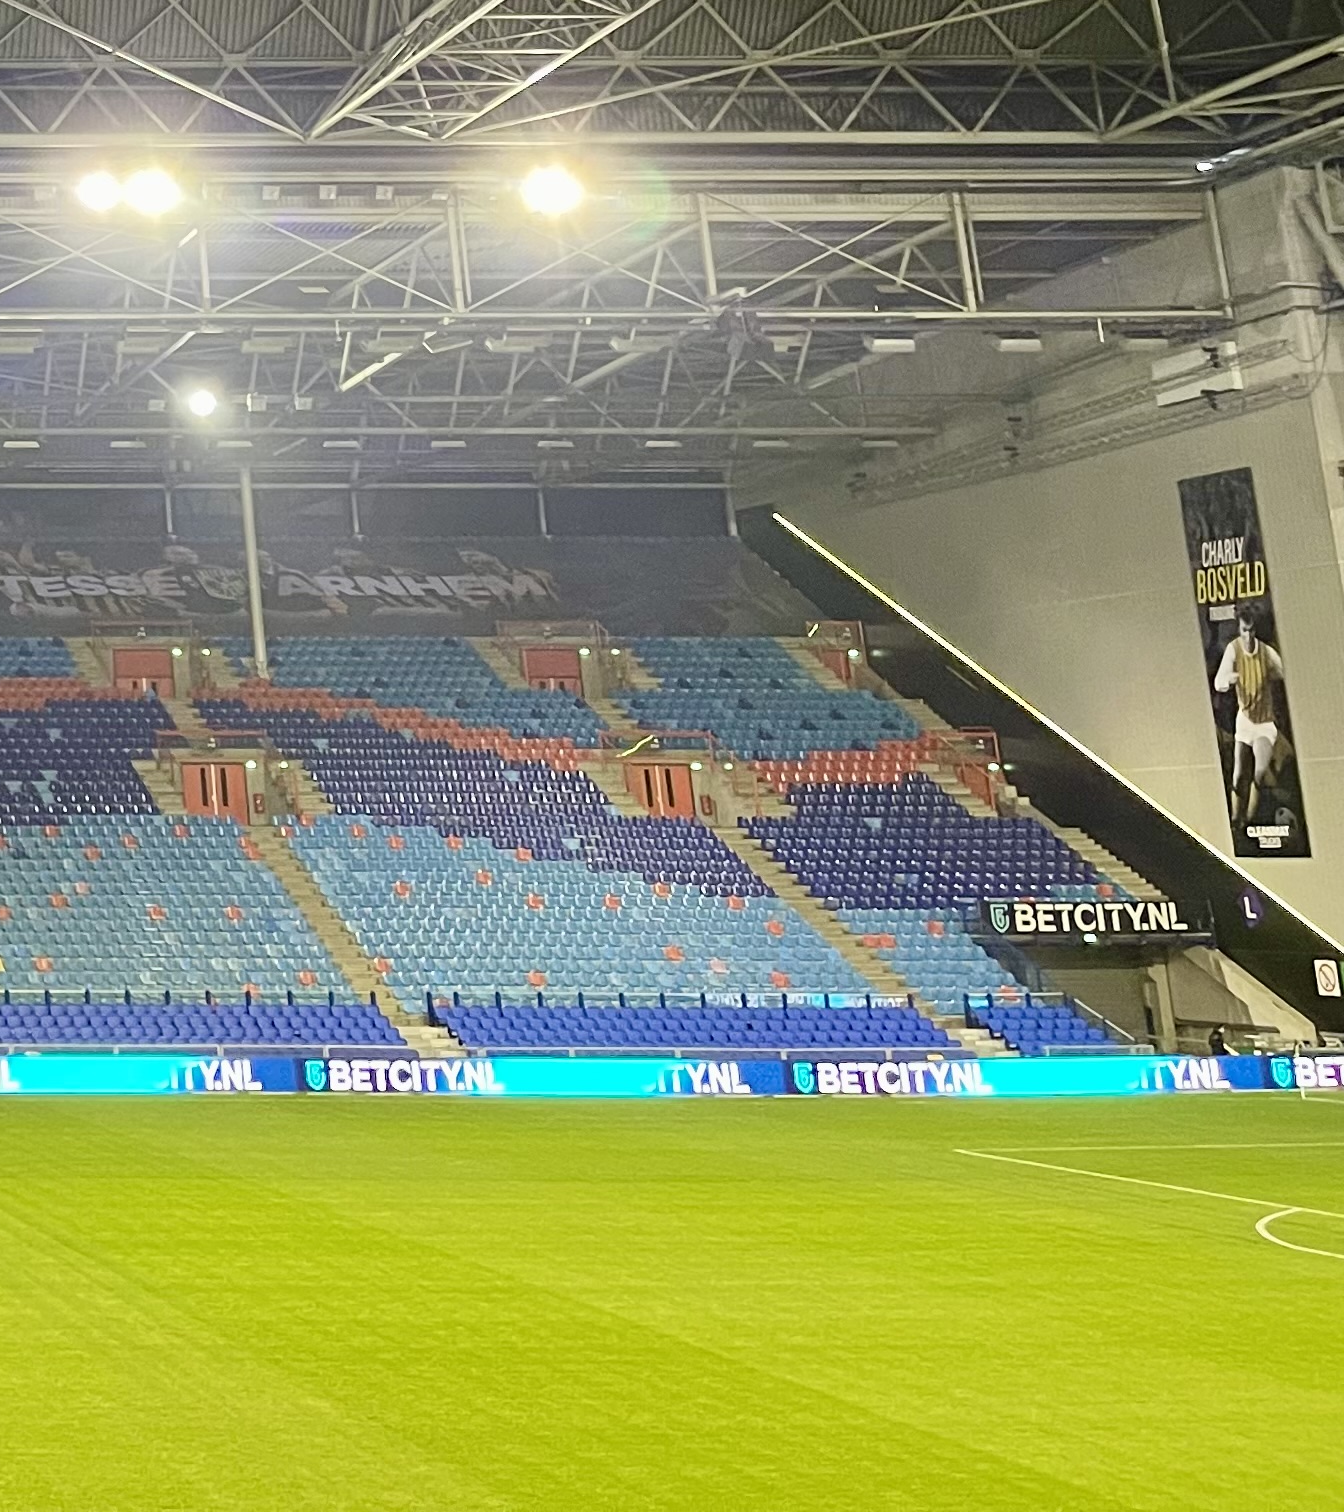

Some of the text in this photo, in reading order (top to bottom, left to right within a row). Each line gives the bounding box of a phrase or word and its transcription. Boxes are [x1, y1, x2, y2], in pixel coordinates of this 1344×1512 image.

[1202, 537, 1244, 567] CHARLY
[277, 574, 550, 597] ARNHEM
[1197, 561, 1265, 604] BOSVELD
[1013, 902, 1188, 932] BETCITY.NL
[328, 1059, 505, 1092] BETCITY.NL
[817, 1062, 993, 1093] BETCITY.NL
[1293, 1056, 1344, 1088] BE
